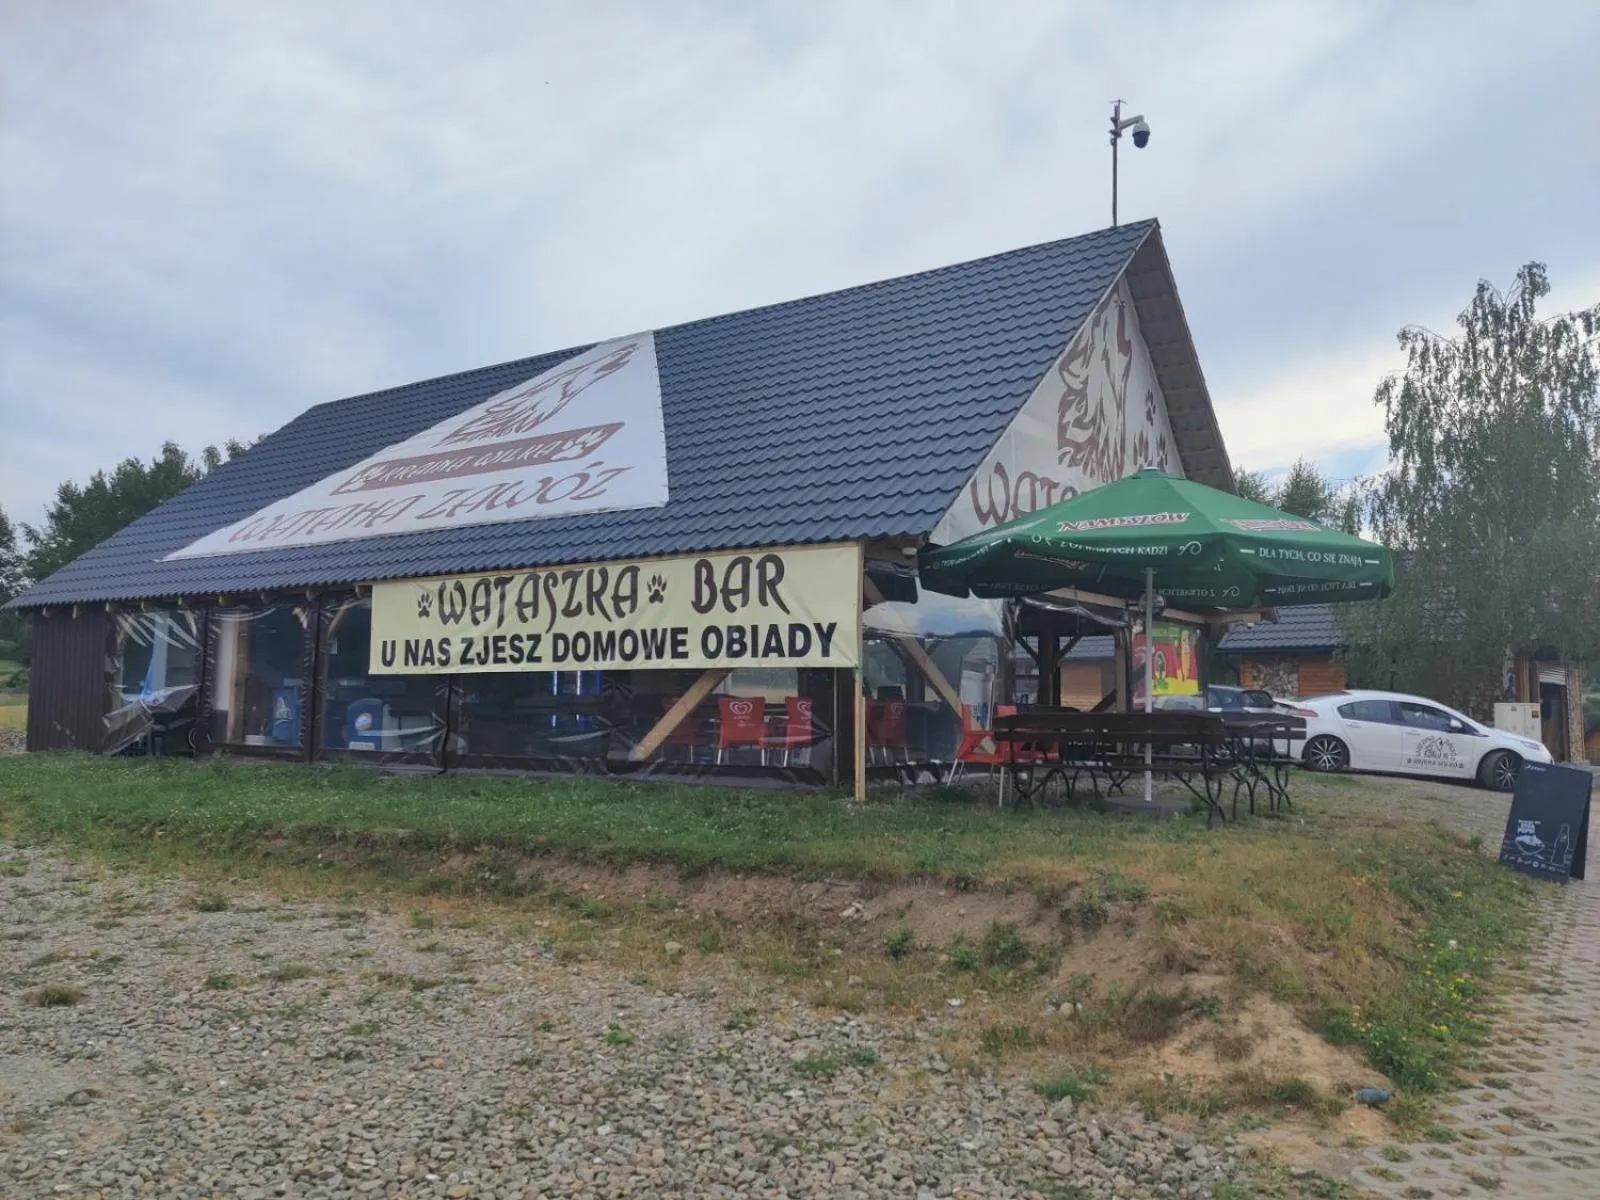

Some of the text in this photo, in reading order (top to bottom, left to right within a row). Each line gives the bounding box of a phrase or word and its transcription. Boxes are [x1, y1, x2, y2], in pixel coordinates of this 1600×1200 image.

[1137, 546, 1168, 556] KADZI
[1259, 547, 1277, 559] DLA
[1307, 551, 1322, 562] CO
[690, 553, 791, 615] BAR
[381, 621, 838, 667] U NAS ZJESZ DOMOWE OBIADY
